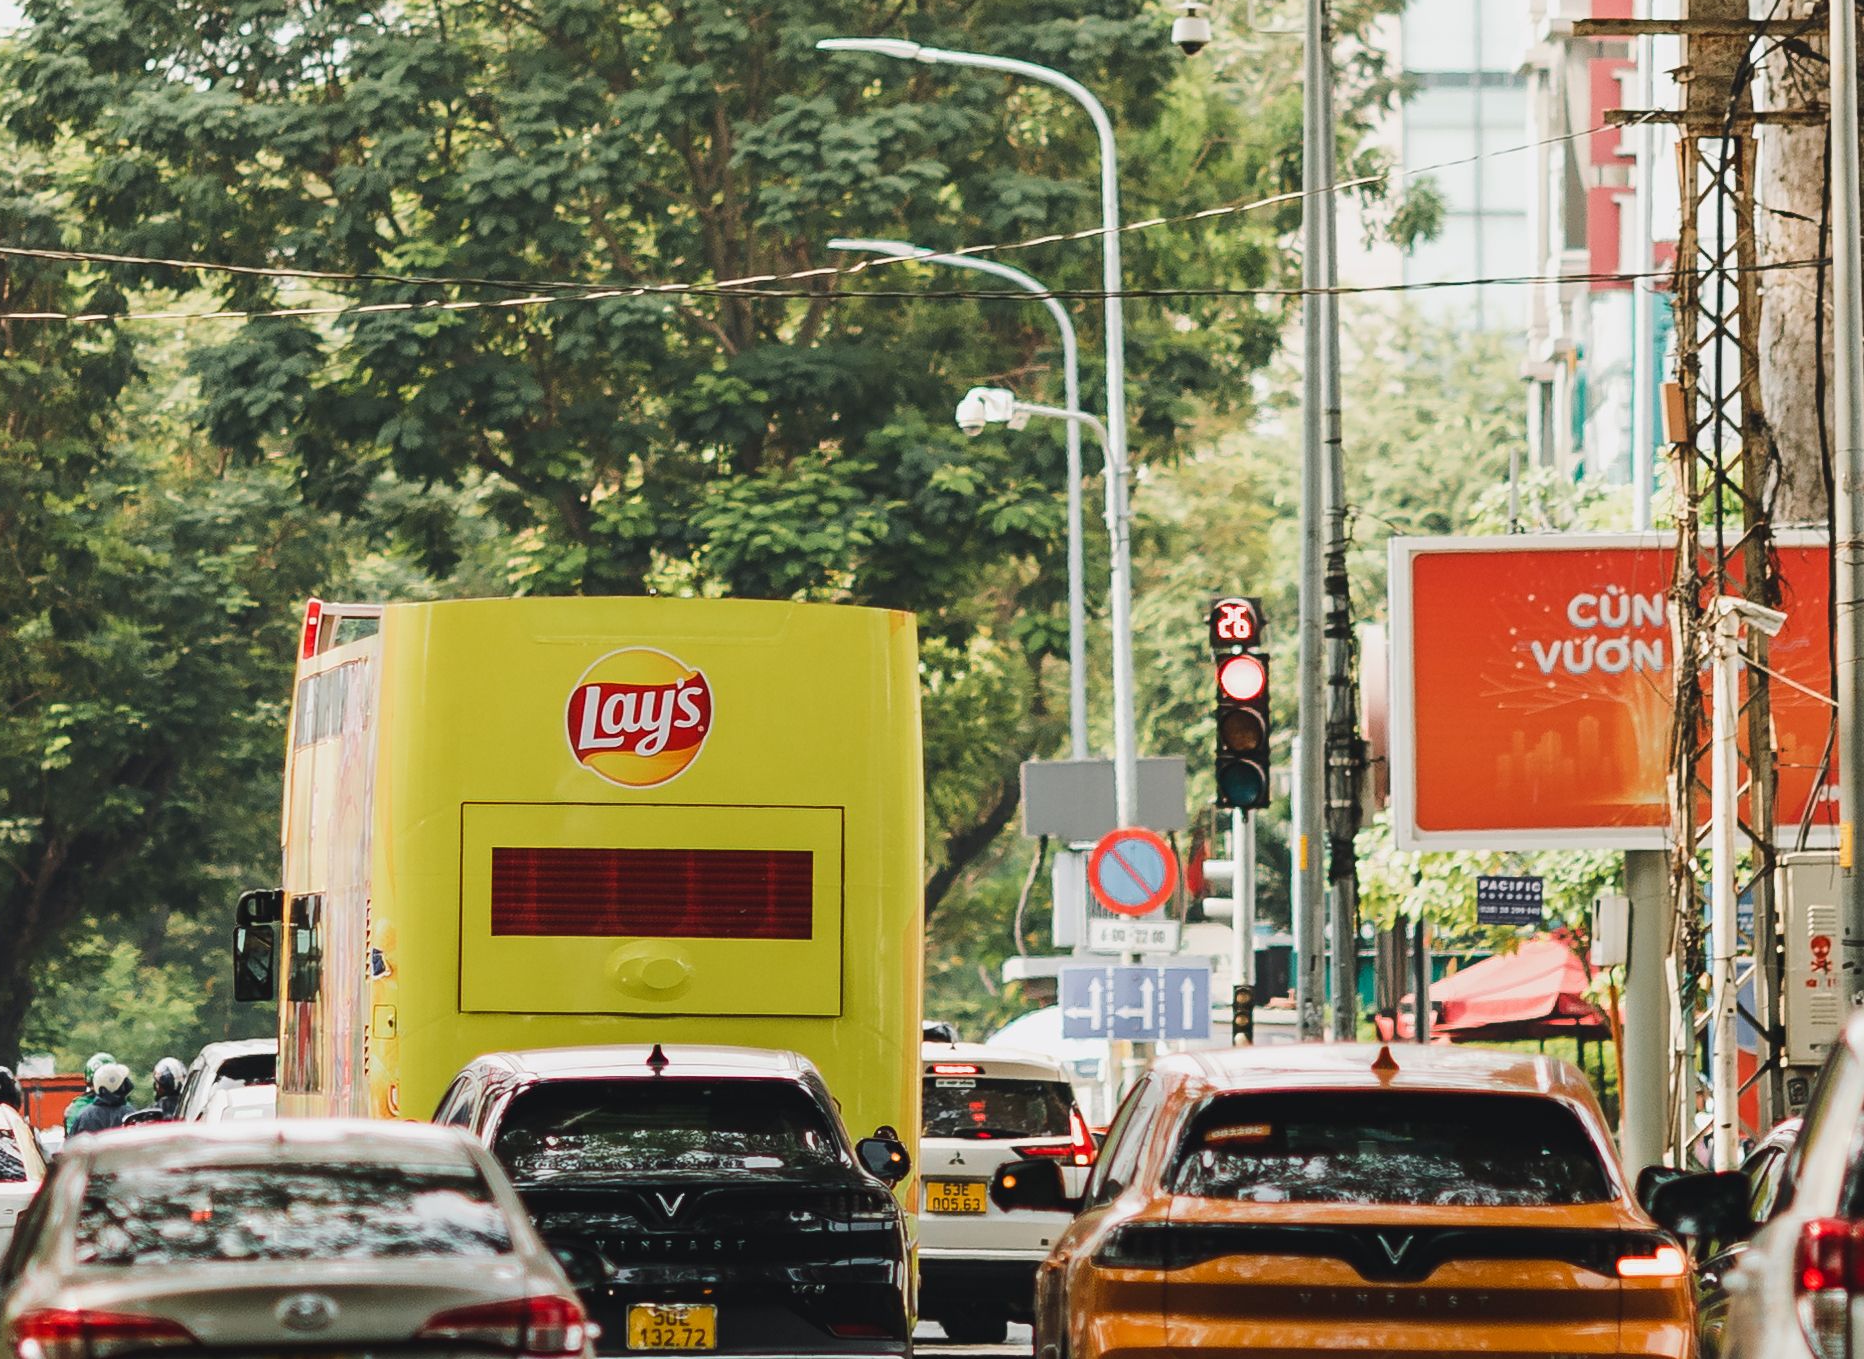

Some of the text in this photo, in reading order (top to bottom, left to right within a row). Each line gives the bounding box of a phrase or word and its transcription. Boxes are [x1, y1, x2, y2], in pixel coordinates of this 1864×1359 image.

[1567, 584, 1665, 628] CÙN
[1531, 634, 1664, 674] VƯƠN
[578, 678, 704, 757] Lay's
[1479, 880, 1542, 892] PACIFIC
[932, 1197, 981, 1211] 005.63
[596, 1240, 746, 1251] VINFAST
[1299, 1292, 1489, 1307] VINFAST
[640, 1328, 707, 1347] 132.72
